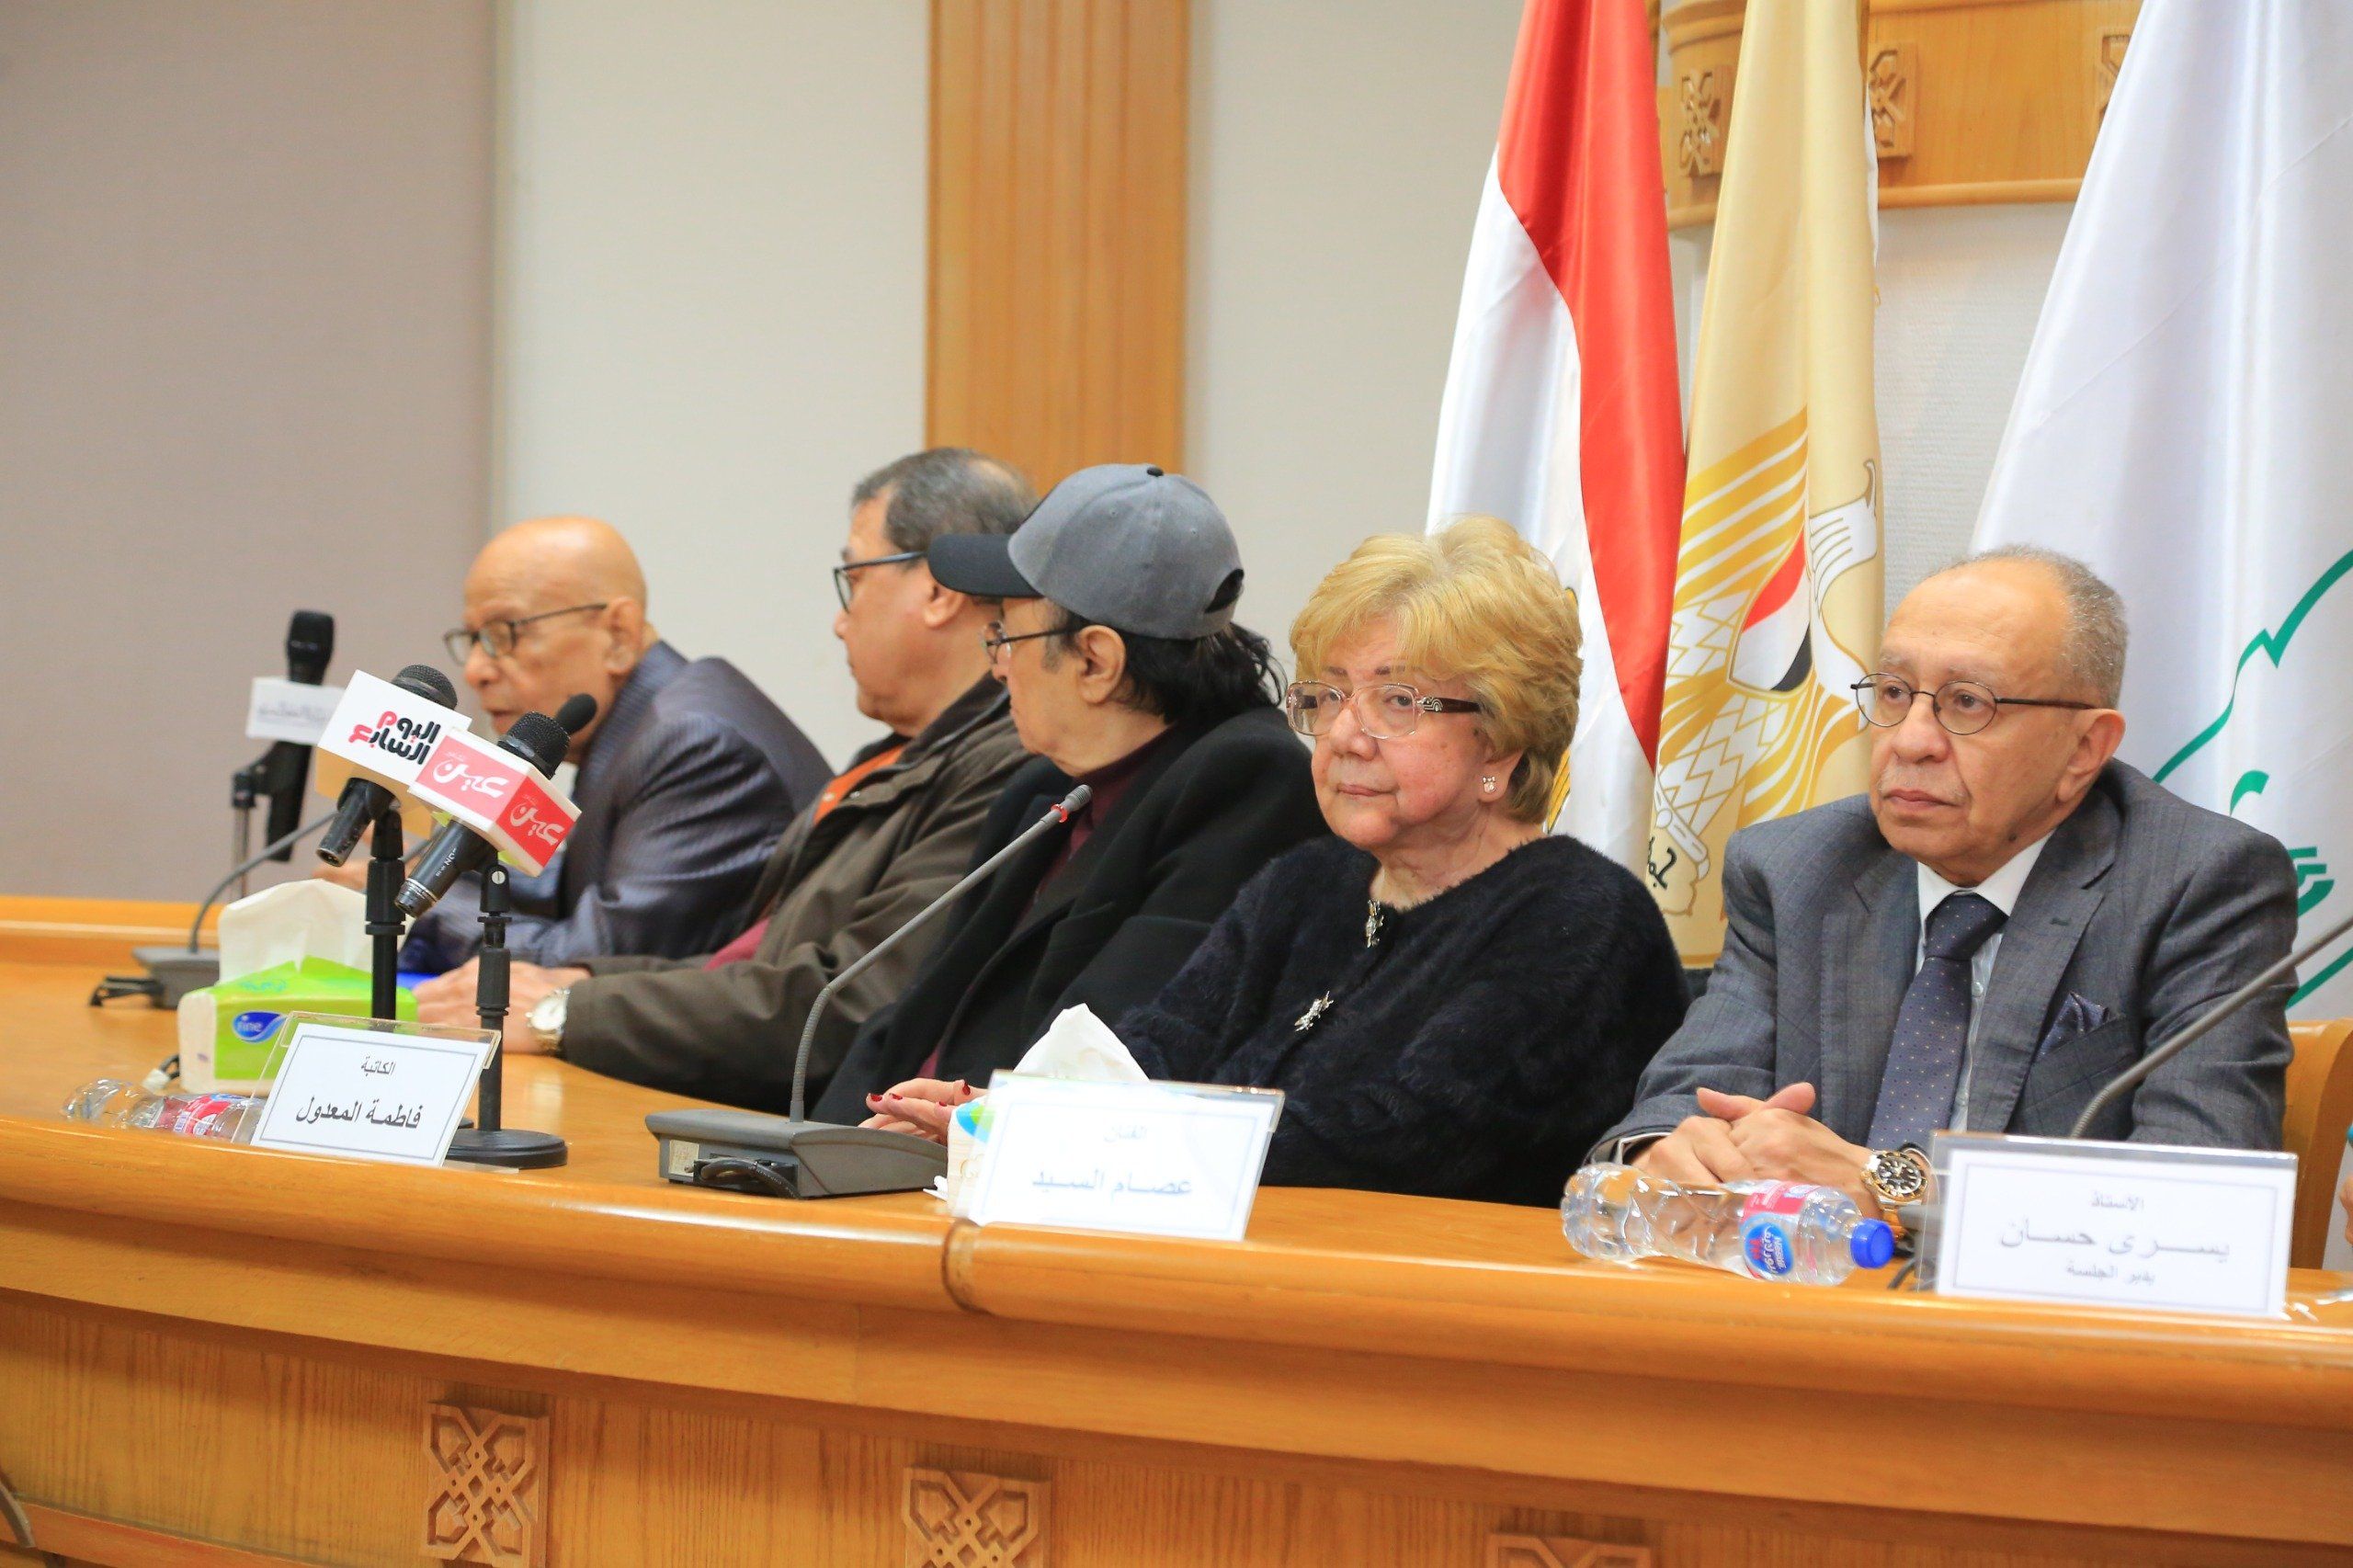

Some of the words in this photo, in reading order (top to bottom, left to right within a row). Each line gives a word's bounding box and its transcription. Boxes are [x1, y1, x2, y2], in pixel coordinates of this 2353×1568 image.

[377, 711, 441, 744] اليوم
[348, 724, 430, 765] السابع
[361, 1056, 396, 1076] الكاتبة
[296, 1096, 361, 1124] المعدول
[366, 1098, 423, 1129] فاطمة
[1111, 1172, 1191, 1206] عصام
[2001, 1216, 2095, 1247] حسان
